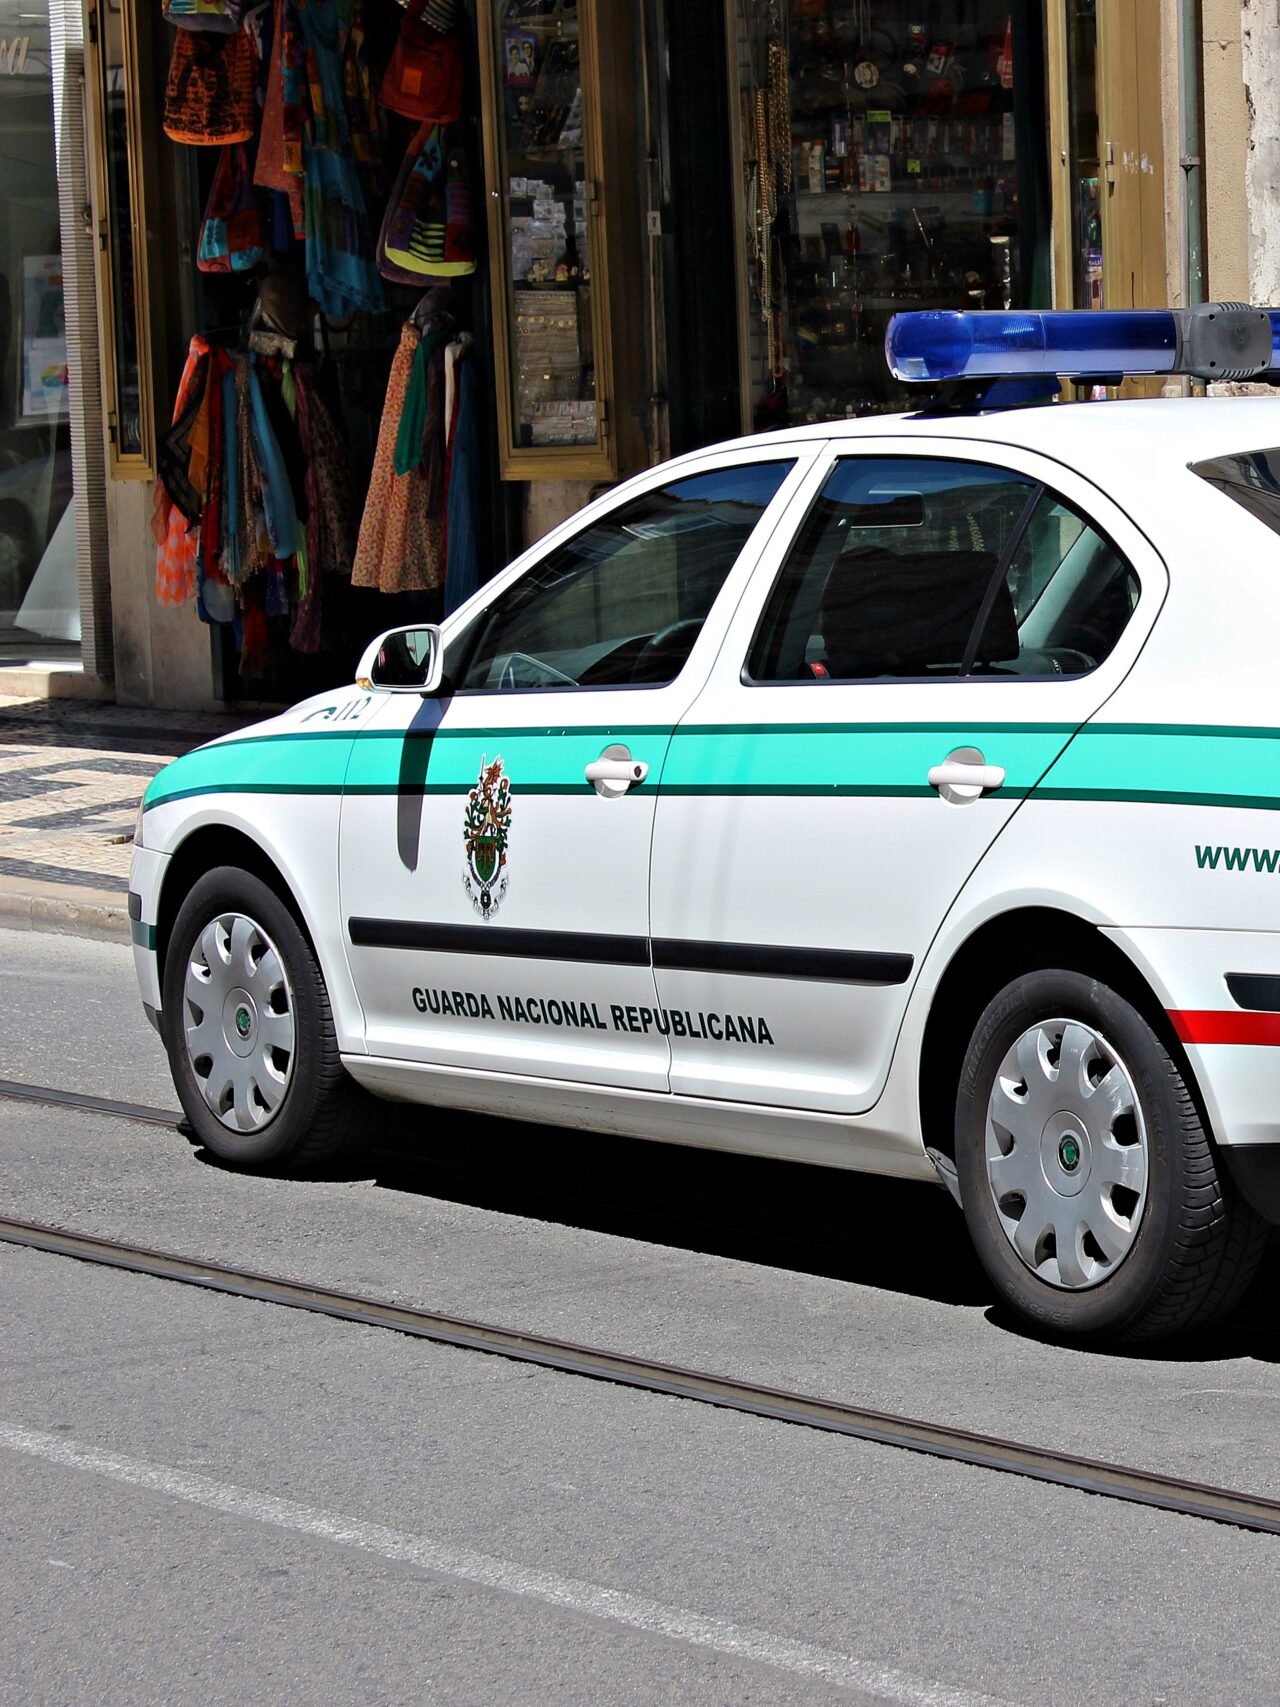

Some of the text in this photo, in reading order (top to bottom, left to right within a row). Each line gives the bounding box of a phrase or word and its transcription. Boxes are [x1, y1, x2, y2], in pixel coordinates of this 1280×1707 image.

[411, 987, 775, 1046] GUARDA NACIONAL REPUBLICANA
